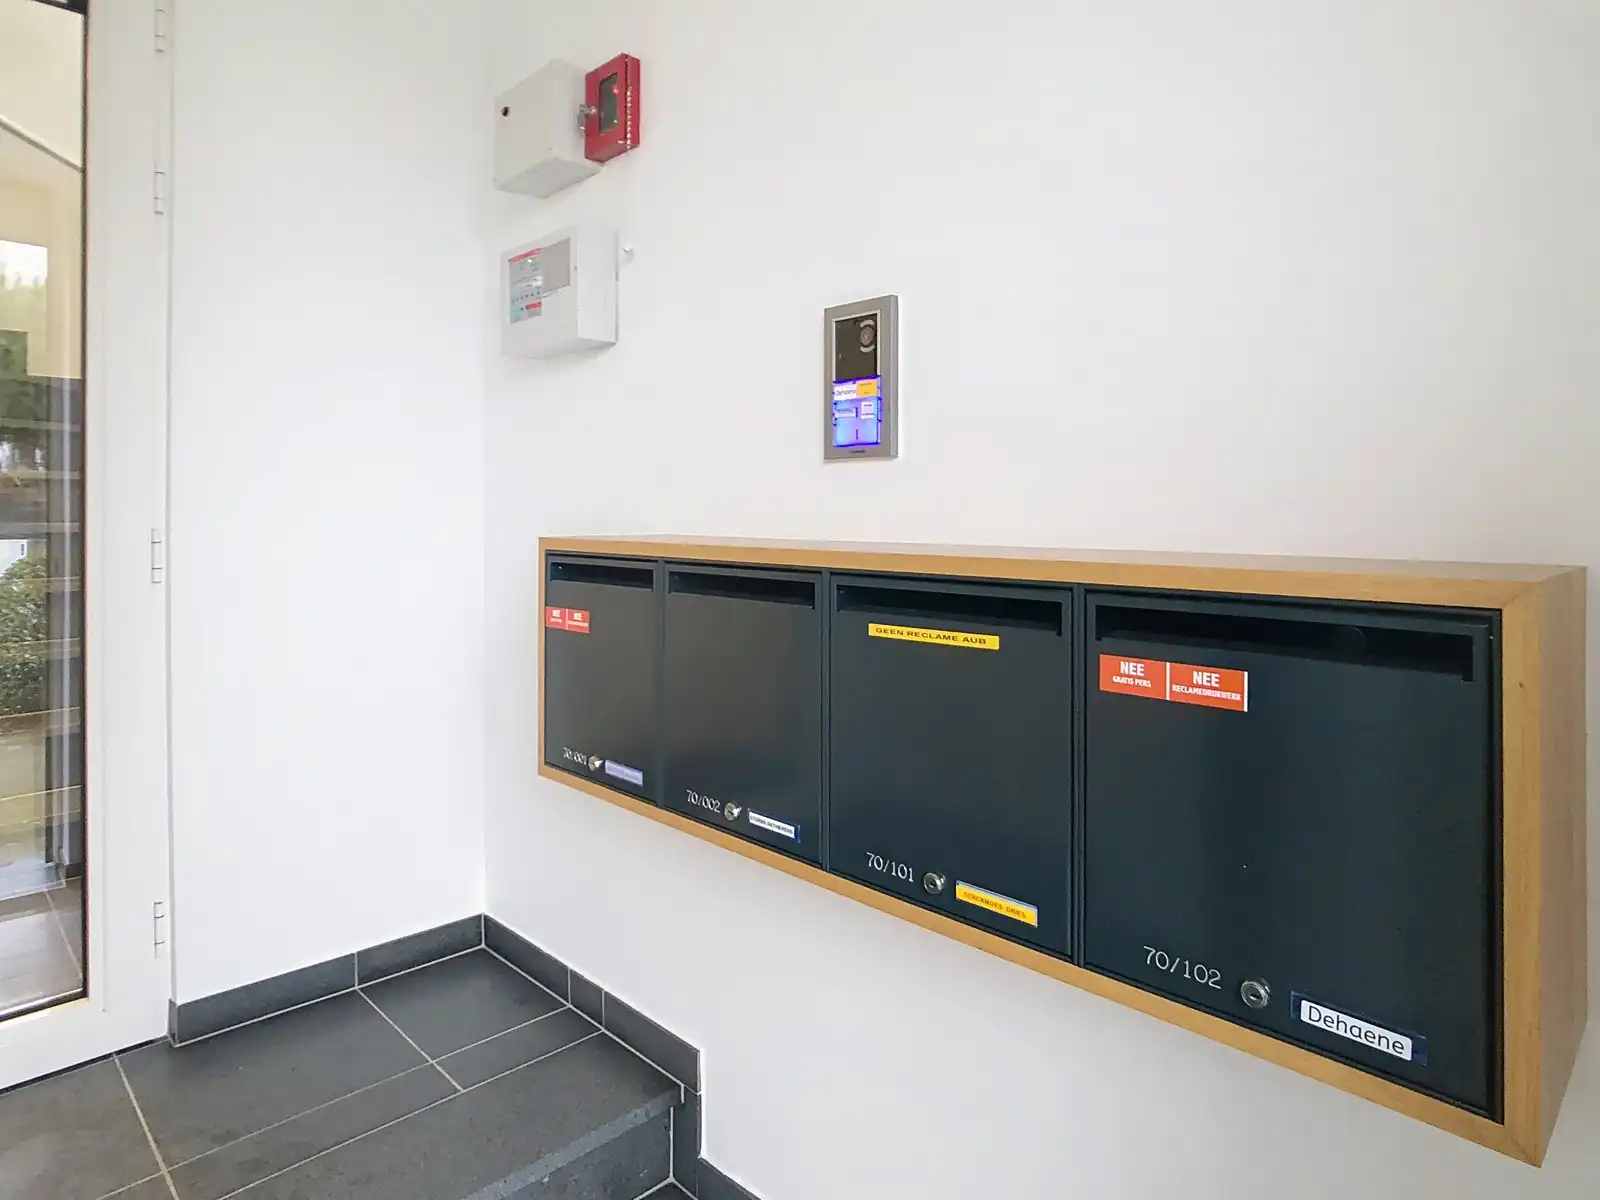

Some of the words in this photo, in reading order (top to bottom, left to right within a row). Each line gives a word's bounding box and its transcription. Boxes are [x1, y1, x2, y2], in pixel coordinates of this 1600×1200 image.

[876, 627, 904, 636] GEEN
[906, 631, 959, 642] RECLAME
[961, 636, 987, 645] AUB
[1119, 660, 1144, 676] NEE
[1111, 675, 1134, 686] GRATIS
[1135, 679, 1152, 688] PERS
[1193, 671, 1219, 687] NEE
[686, 789, 721, 814] 70/002
[866, 851, 914, 883] 70/101
[1143, 945, 1222, 990] 70/102
[1307, 1004, 1405, 1055] Dehaene
